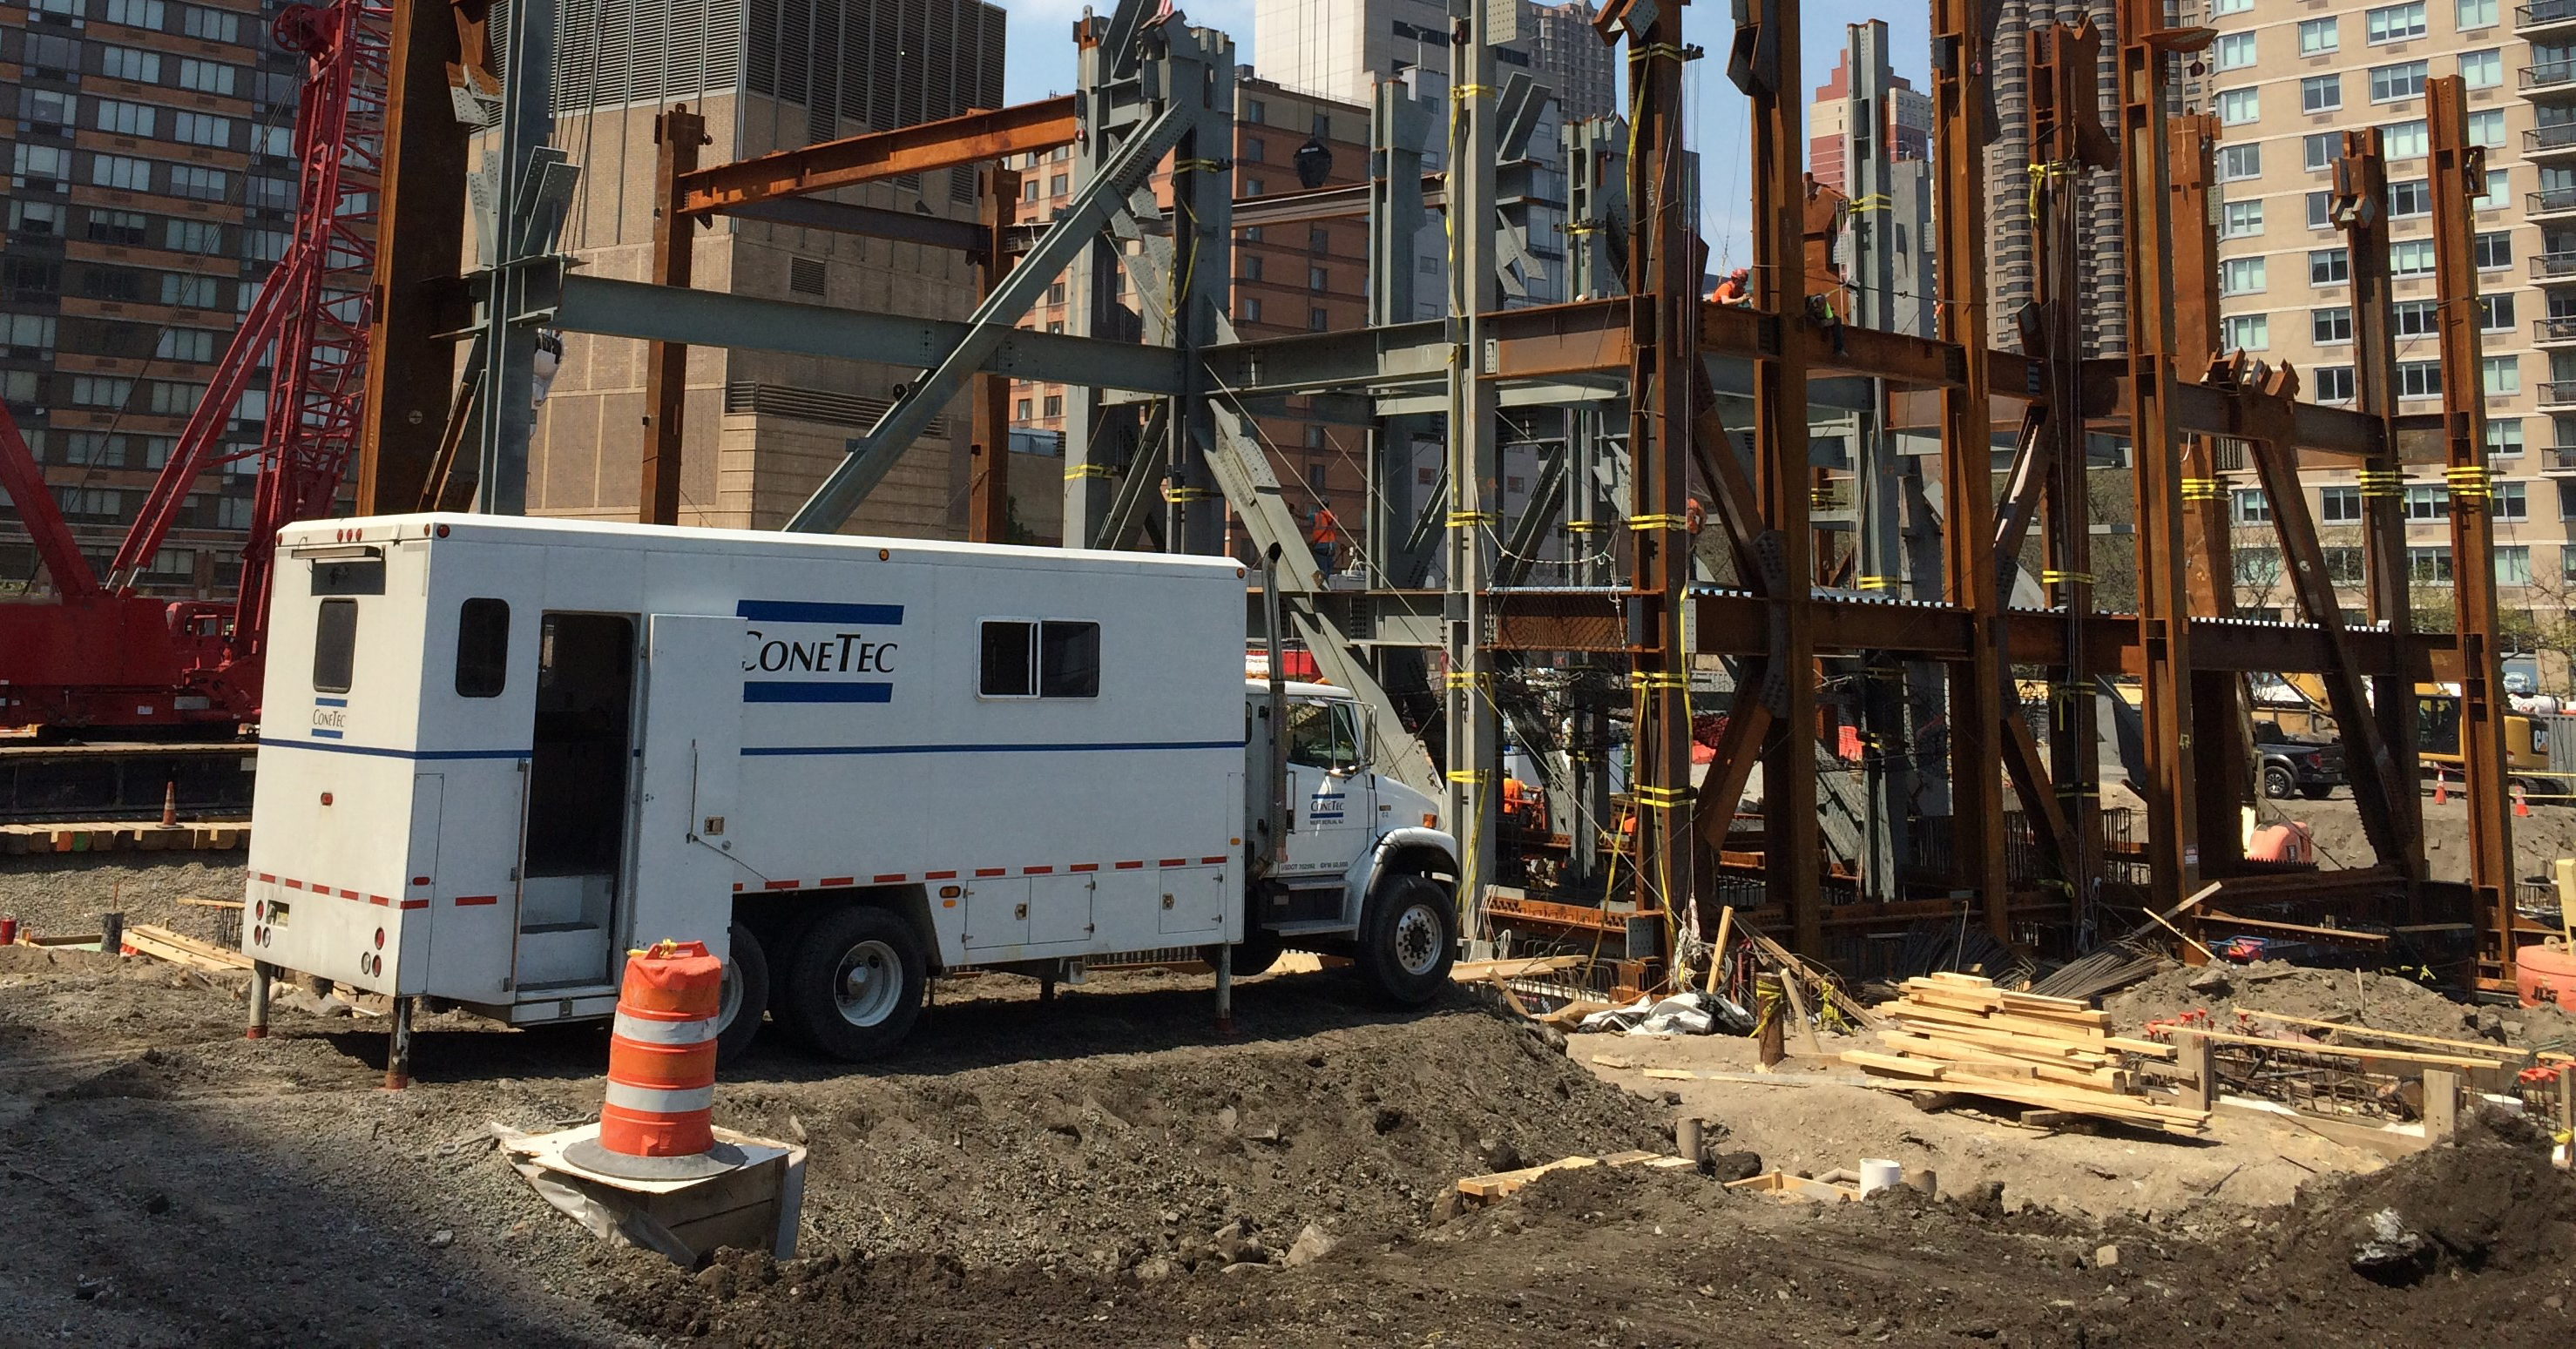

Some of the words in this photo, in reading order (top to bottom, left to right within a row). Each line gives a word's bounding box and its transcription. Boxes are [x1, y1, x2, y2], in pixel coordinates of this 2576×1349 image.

[742, 630, 898, 673] ConeTec
[313, 708, 346, 727] ConeTec
[2534, 730, 2549, 752] CA
[1310, 800, 1344, 812] ConeTec
